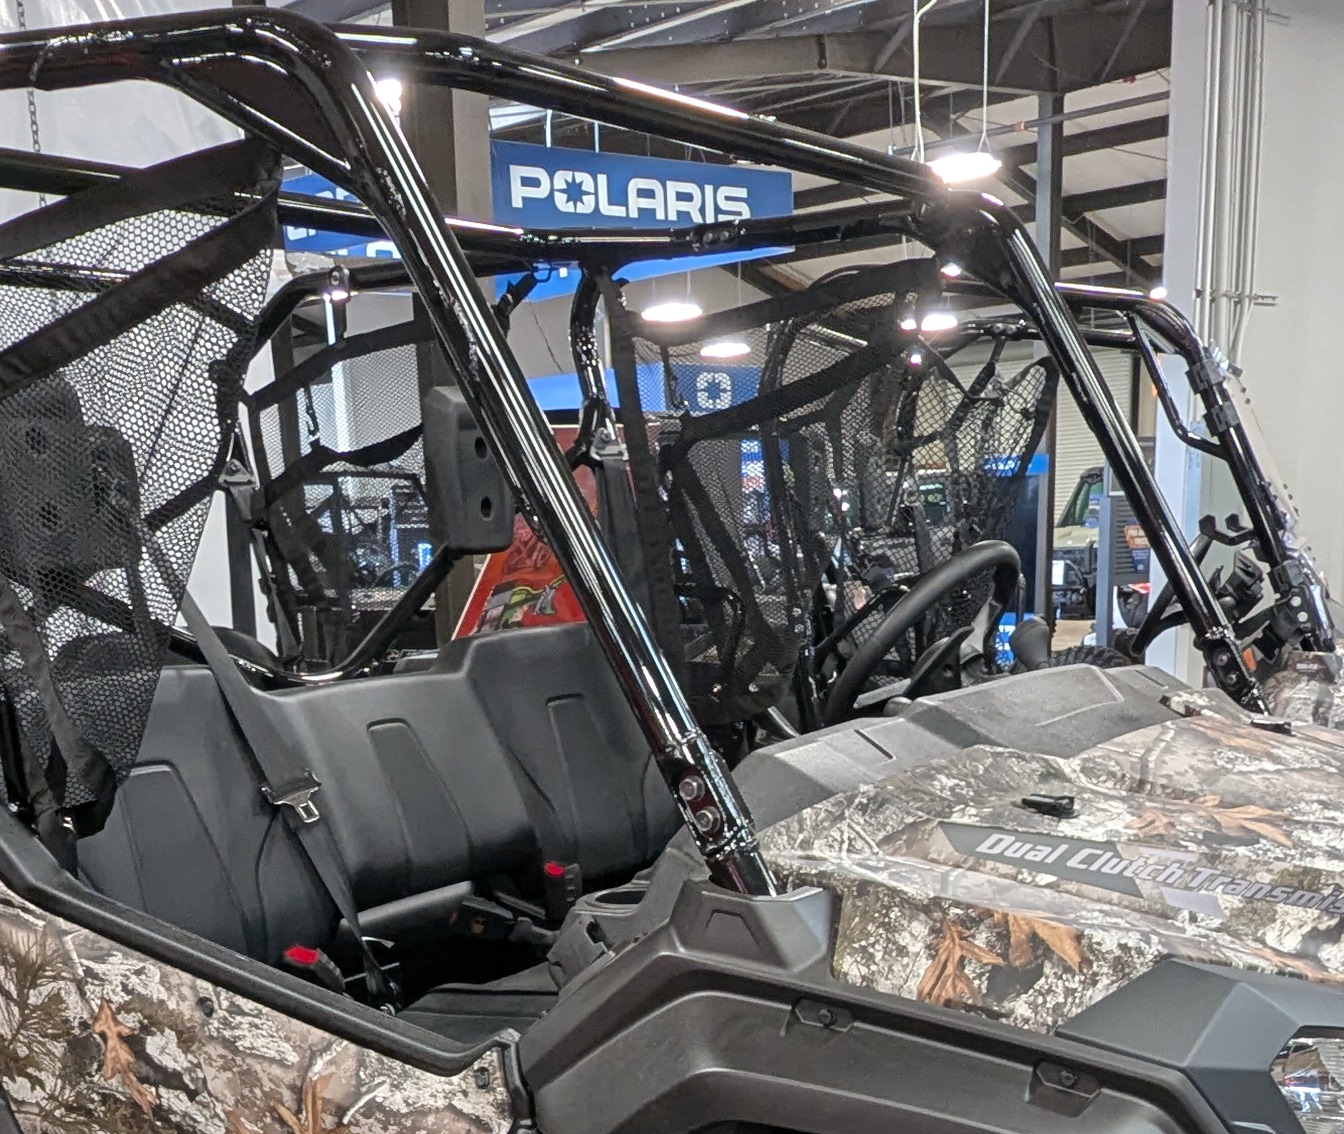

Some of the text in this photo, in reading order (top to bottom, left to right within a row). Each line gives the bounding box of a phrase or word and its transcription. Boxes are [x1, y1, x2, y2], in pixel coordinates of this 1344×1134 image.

[509, 164, 751, 224] POLARIS
[975, 833, 1069, 864] Dual
[1066, 848, 1185, 884] Clutch
